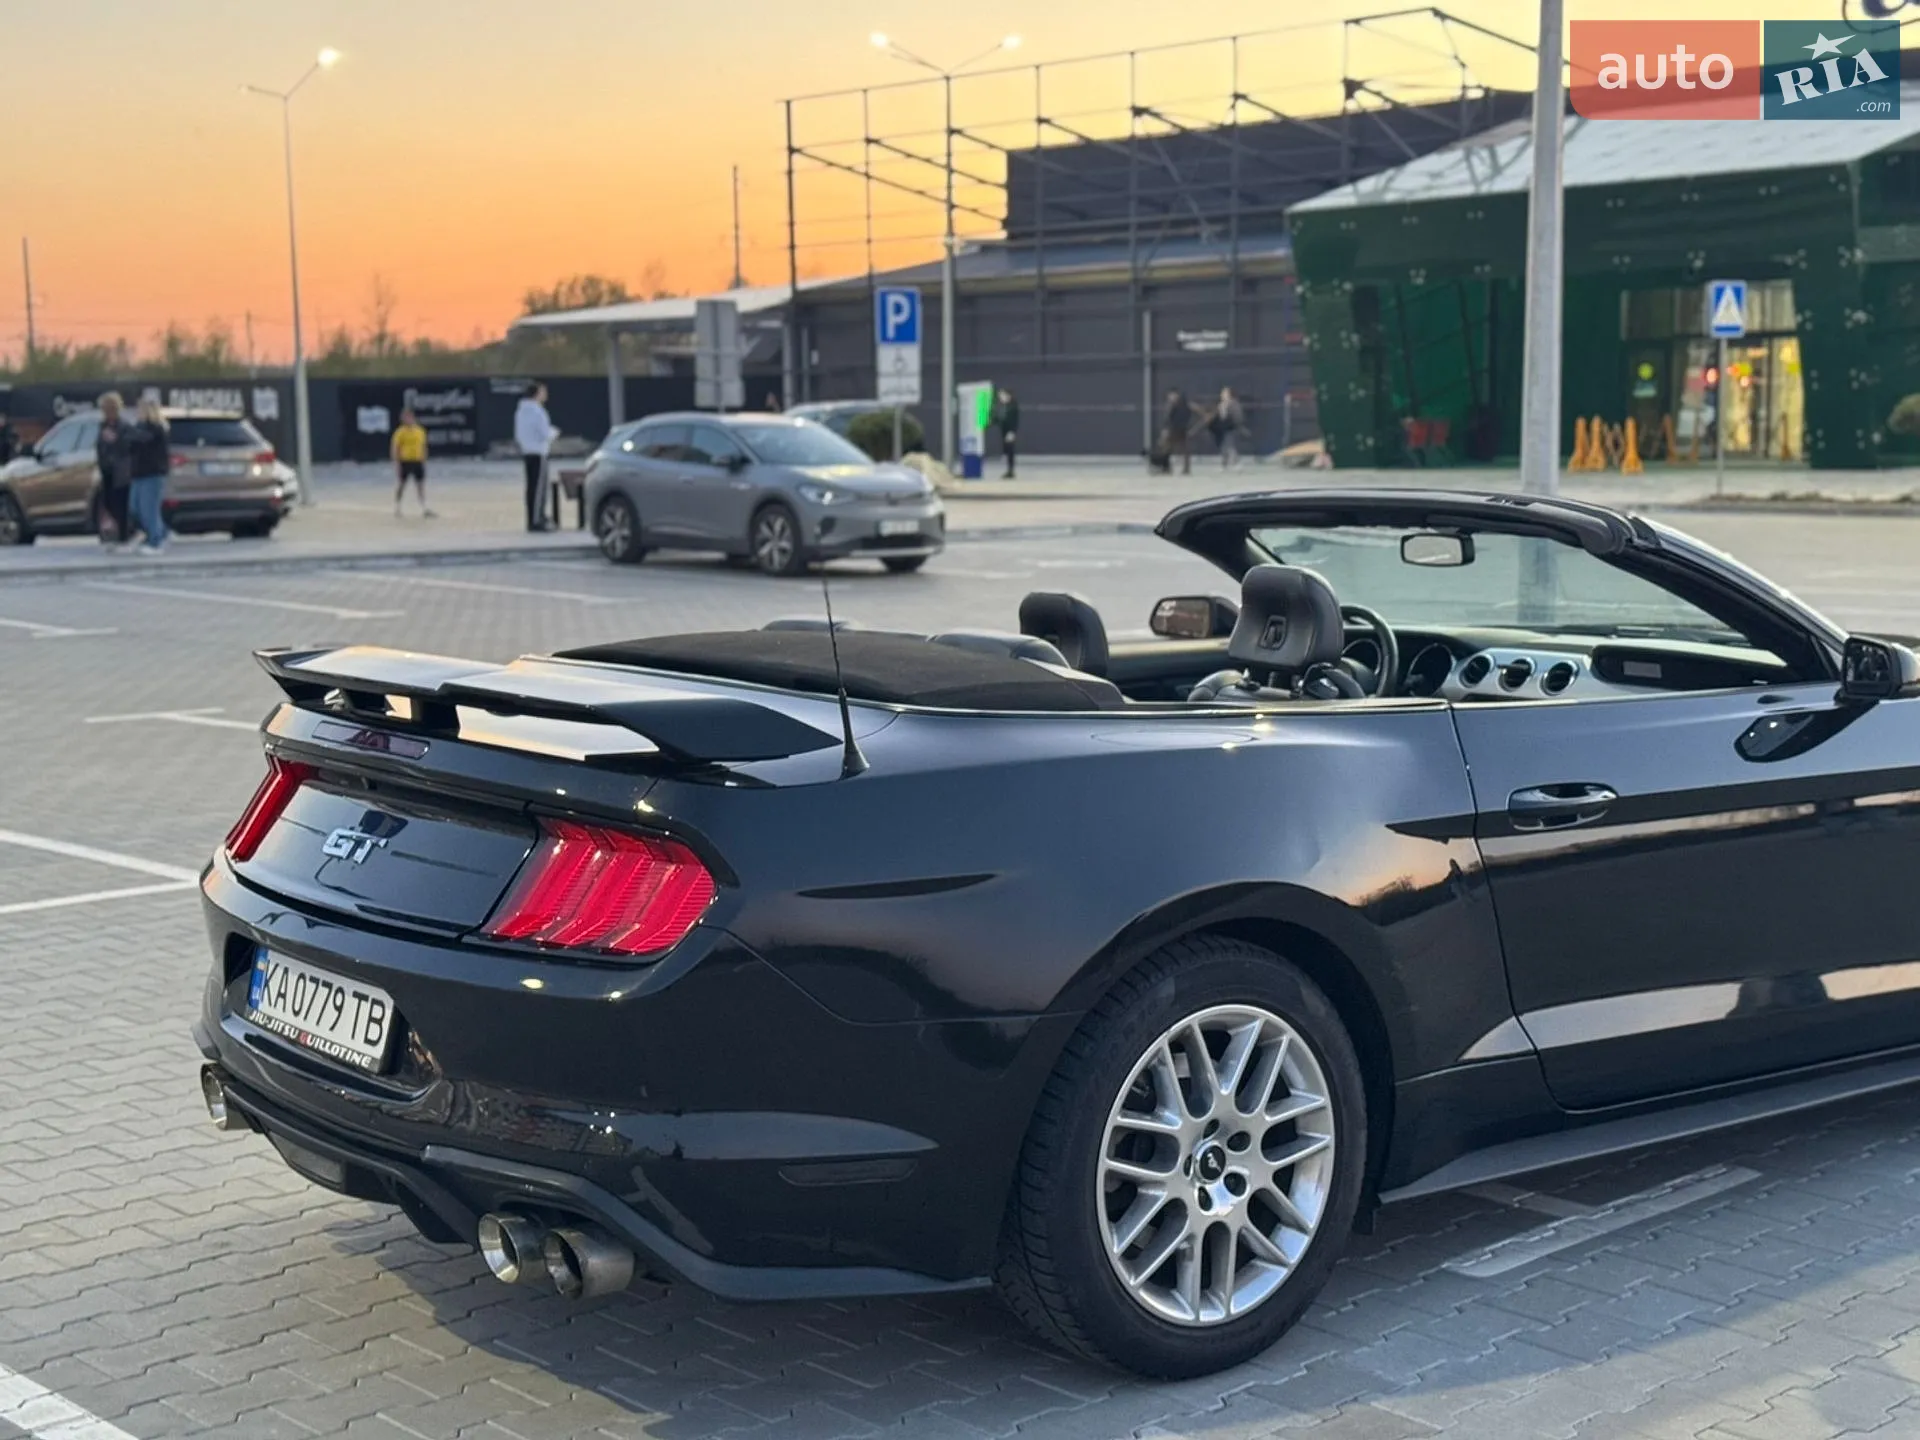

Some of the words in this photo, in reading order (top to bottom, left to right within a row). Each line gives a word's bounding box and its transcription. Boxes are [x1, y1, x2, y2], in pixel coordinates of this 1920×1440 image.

[885, 292, 912, 340] P
[322, 827, 389, 865] GT
[249, 1010, 300, 1039] JIU-JITSU
[299, 1032, 373, 1069] GUILLOTINE
